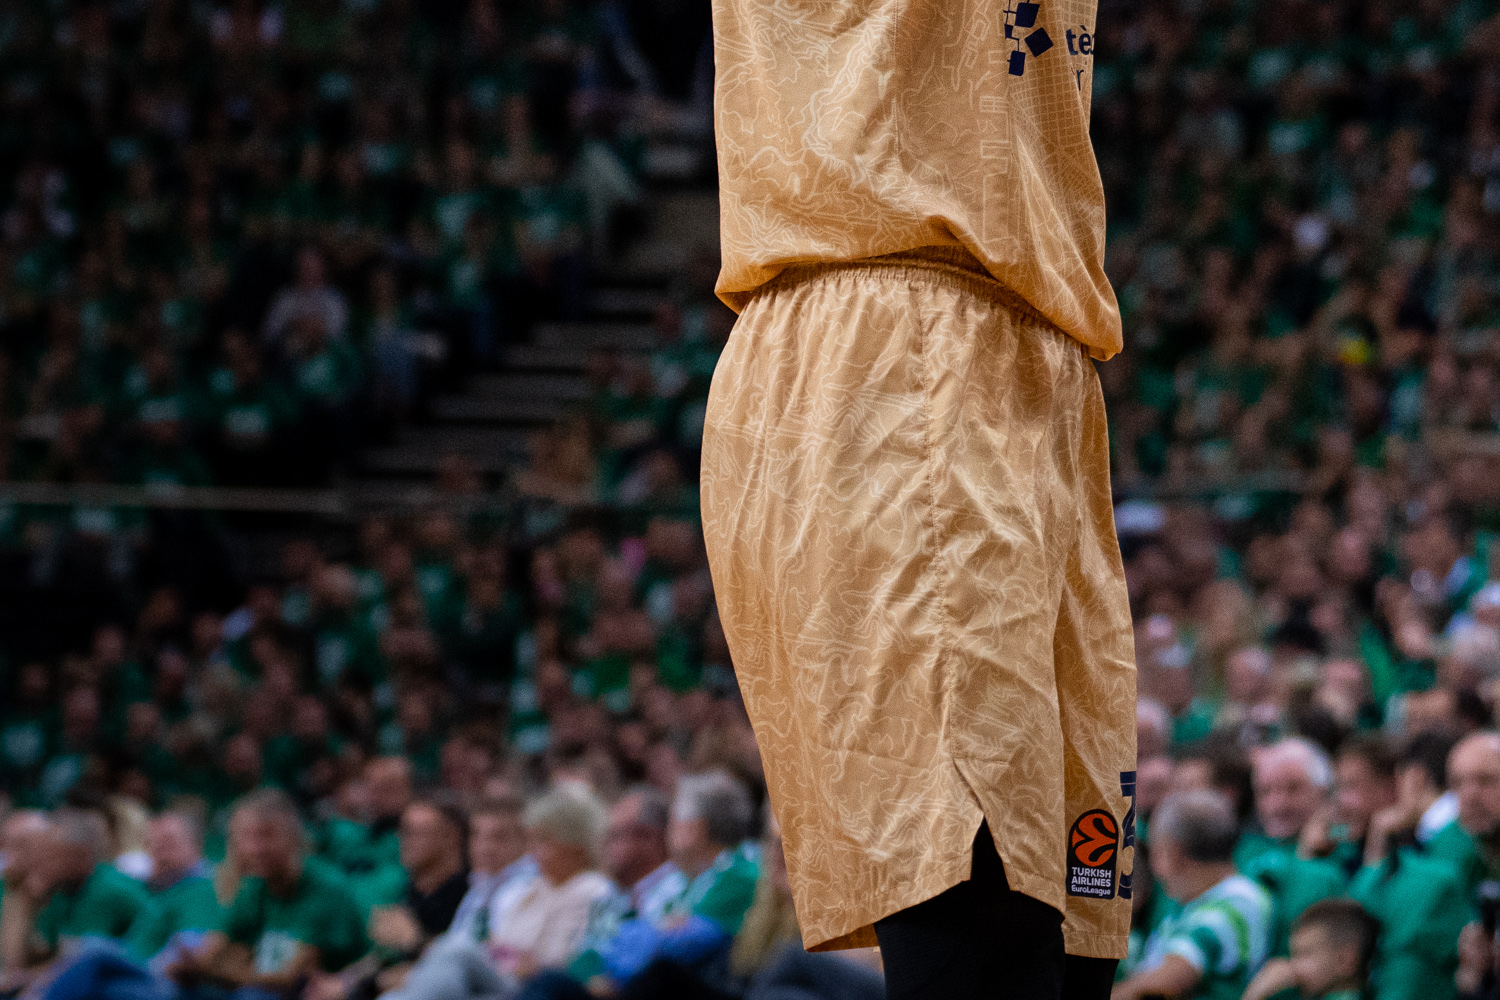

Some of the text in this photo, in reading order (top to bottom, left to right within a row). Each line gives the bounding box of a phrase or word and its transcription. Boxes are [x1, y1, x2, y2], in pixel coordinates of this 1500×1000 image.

[1071, 866, 1112, 879] TURKISH
[1071, 876, 1112, 887] AIRLINES
[1071, 884, 1111, 897] EuroLeague
